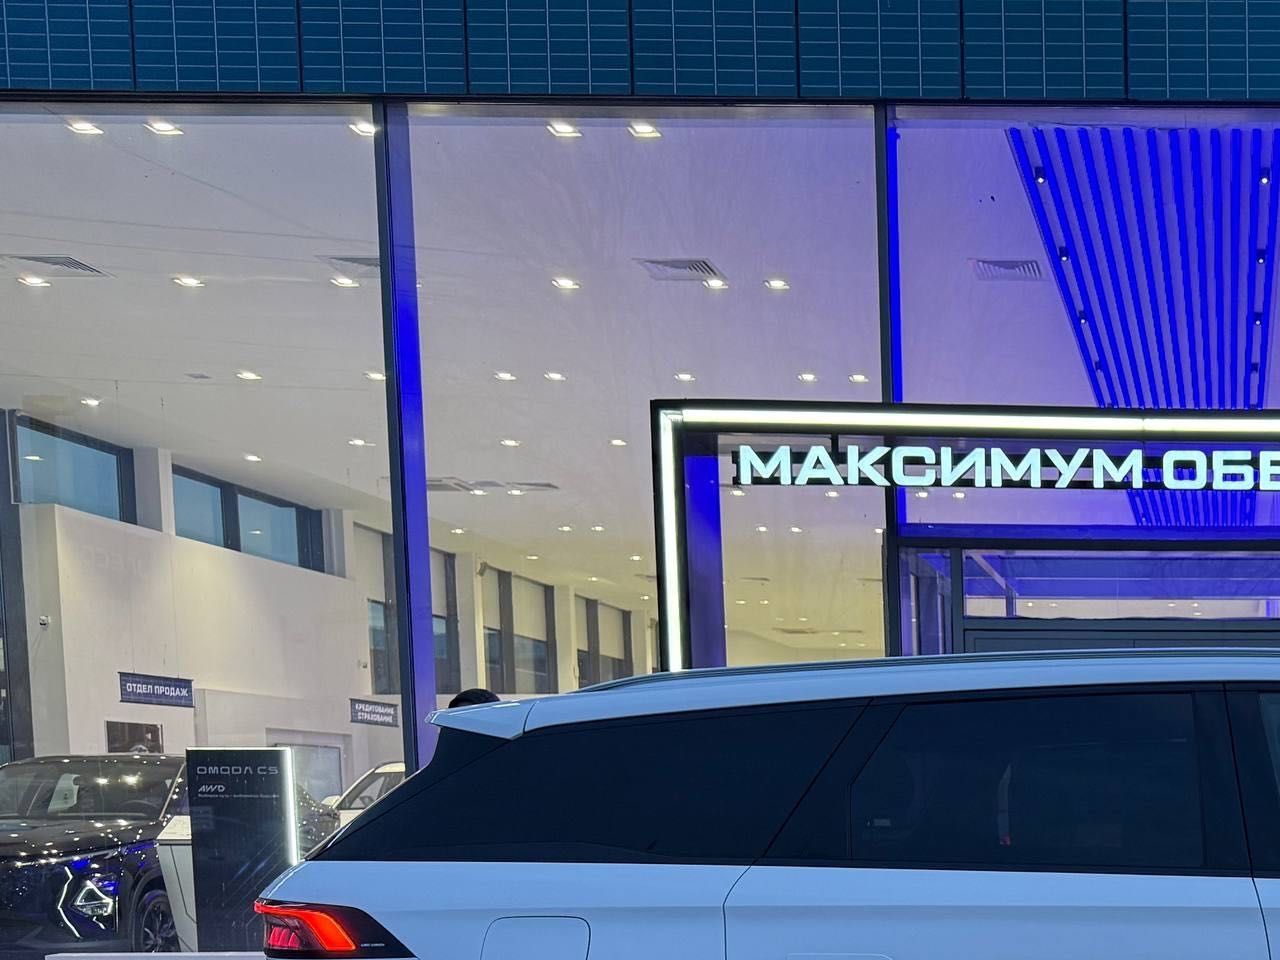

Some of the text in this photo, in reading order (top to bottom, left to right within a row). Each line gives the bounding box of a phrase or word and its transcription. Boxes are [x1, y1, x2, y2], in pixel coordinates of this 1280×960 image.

[738, 444, 1143, 488] МАКСИМУМ
[126, 682, 189, 697] ОТДЕЛ ПРОДАЖ
[196, 766, 253, 775] OMODA
[198, 784, 225, 793] AWD
